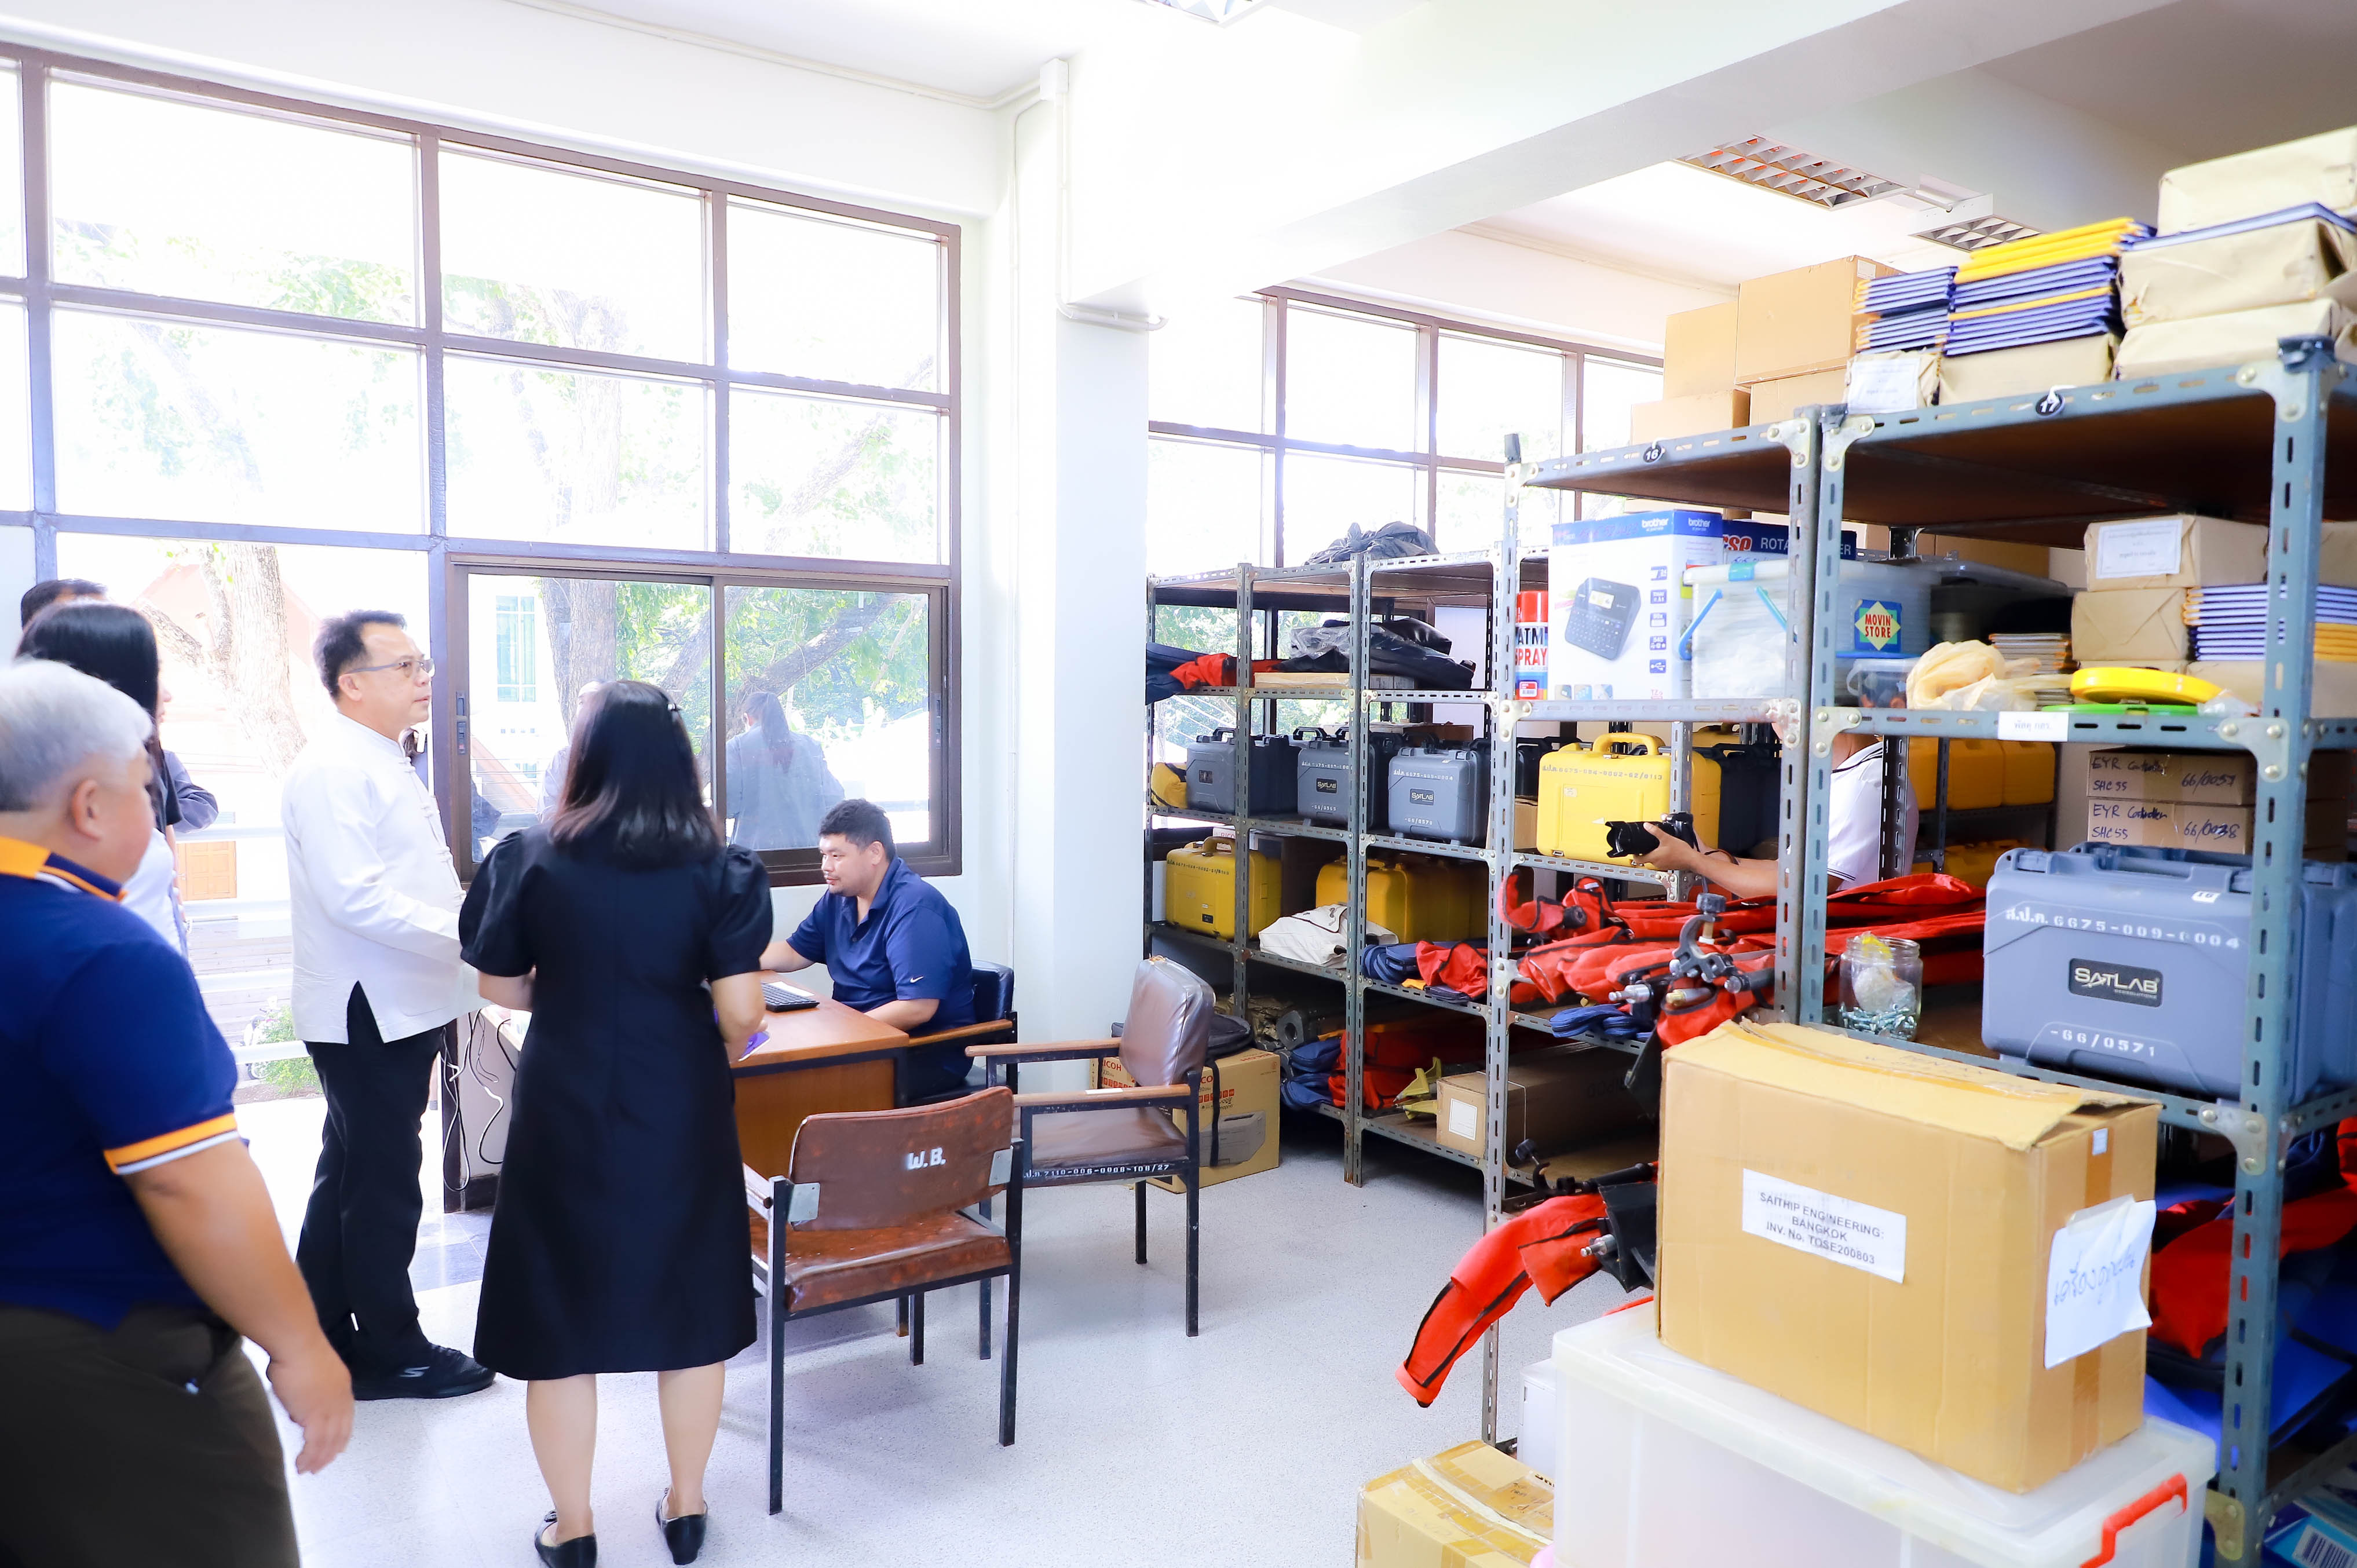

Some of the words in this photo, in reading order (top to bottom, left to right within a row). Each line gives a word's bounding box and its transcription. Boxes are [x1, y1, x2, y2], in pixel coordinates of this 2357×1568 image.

[1646, 448, 1660, 460] 16
[1642, 518, 1668, 528] brother
[1688, 517, 1711, 528] brother
[1761, 537, 1789, 550] ROTA
[1865, 614, 1893, 626] MOVIN'
[1865, 626, 1891, 638] STORE
[2091, 757, 2121, 770] EYR
[1411, 792, 1434, 801] SATLAB
[2093, 804, 2120, 818] EYR
[2074, 967, 2158, 995] SATLAB
[1103, 1059, 1122, 1072] ICOH
[907, 1147, 947, 1170] W.B.
[1759, 1192, 1801, 1211] SAITHIP
[1792, 1216, 1848, 1241] BANGKOK
[1767, 1221, 1786, 1236] INV.
[1788, 1227, 1804, 1242] No.
[1808, 1235, 1875, 1264] TOSE200803
